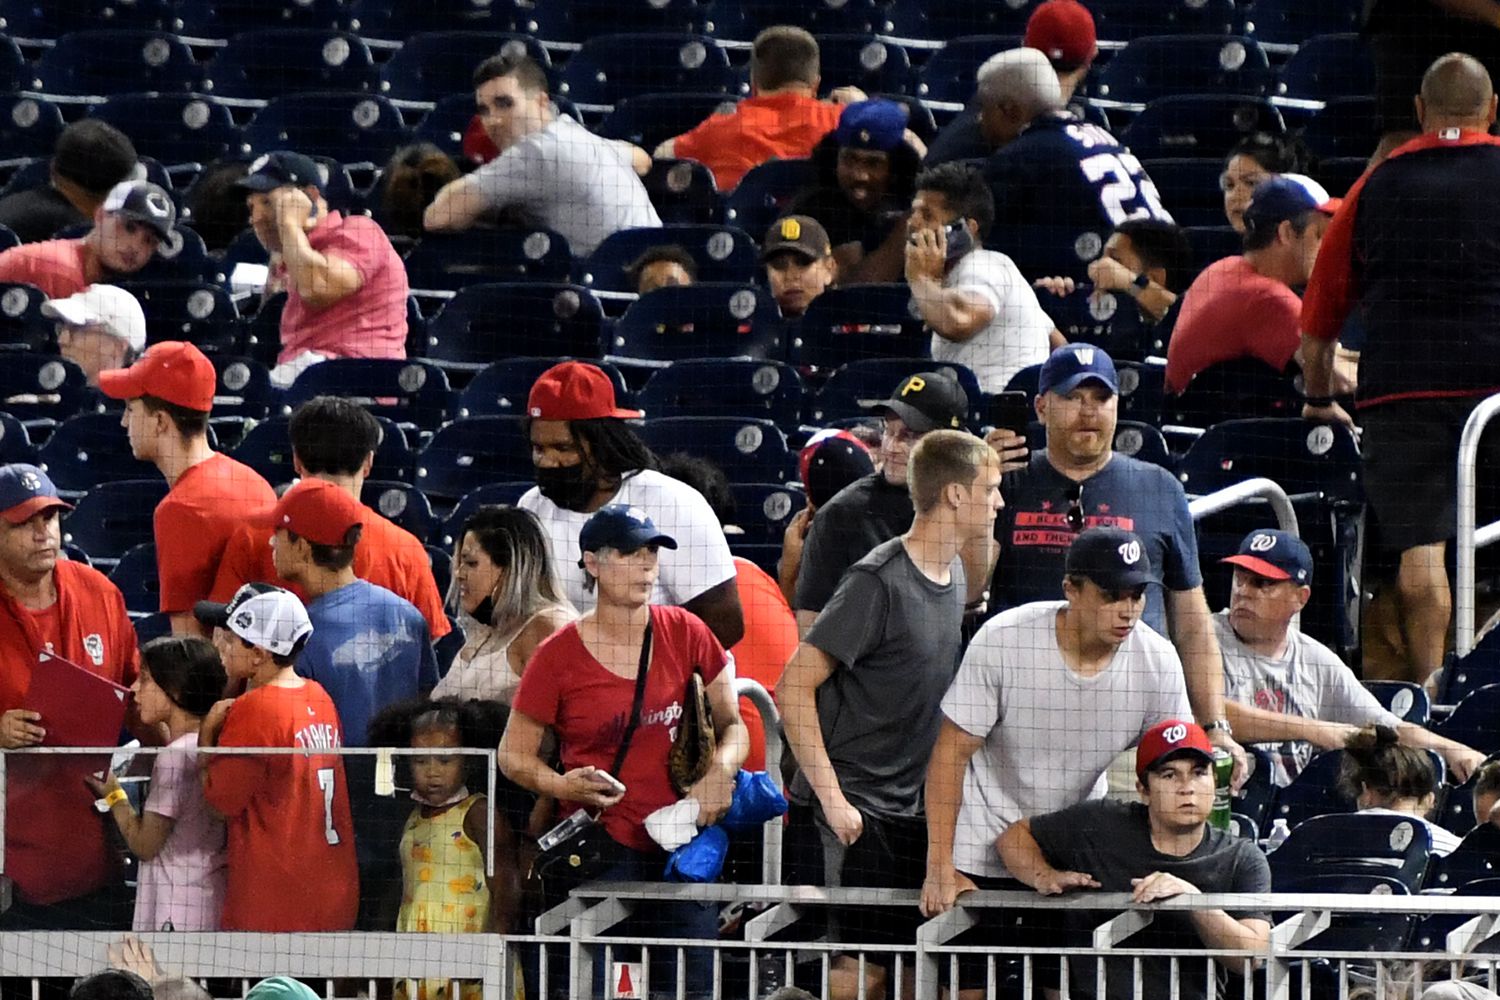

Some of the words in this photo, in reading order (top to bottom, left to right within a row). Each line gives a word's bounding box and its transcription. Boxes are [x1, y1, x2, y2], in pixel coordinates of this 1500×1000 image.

[902, 376, 926, 397] P
[1015, 533, 1038, 542] AND
[1251, 533, 1277, 552] W
[1118, 540, 1141, 565] W
[1162, 723, 1187, 744] W
[317, 768, 340, 845] 7
